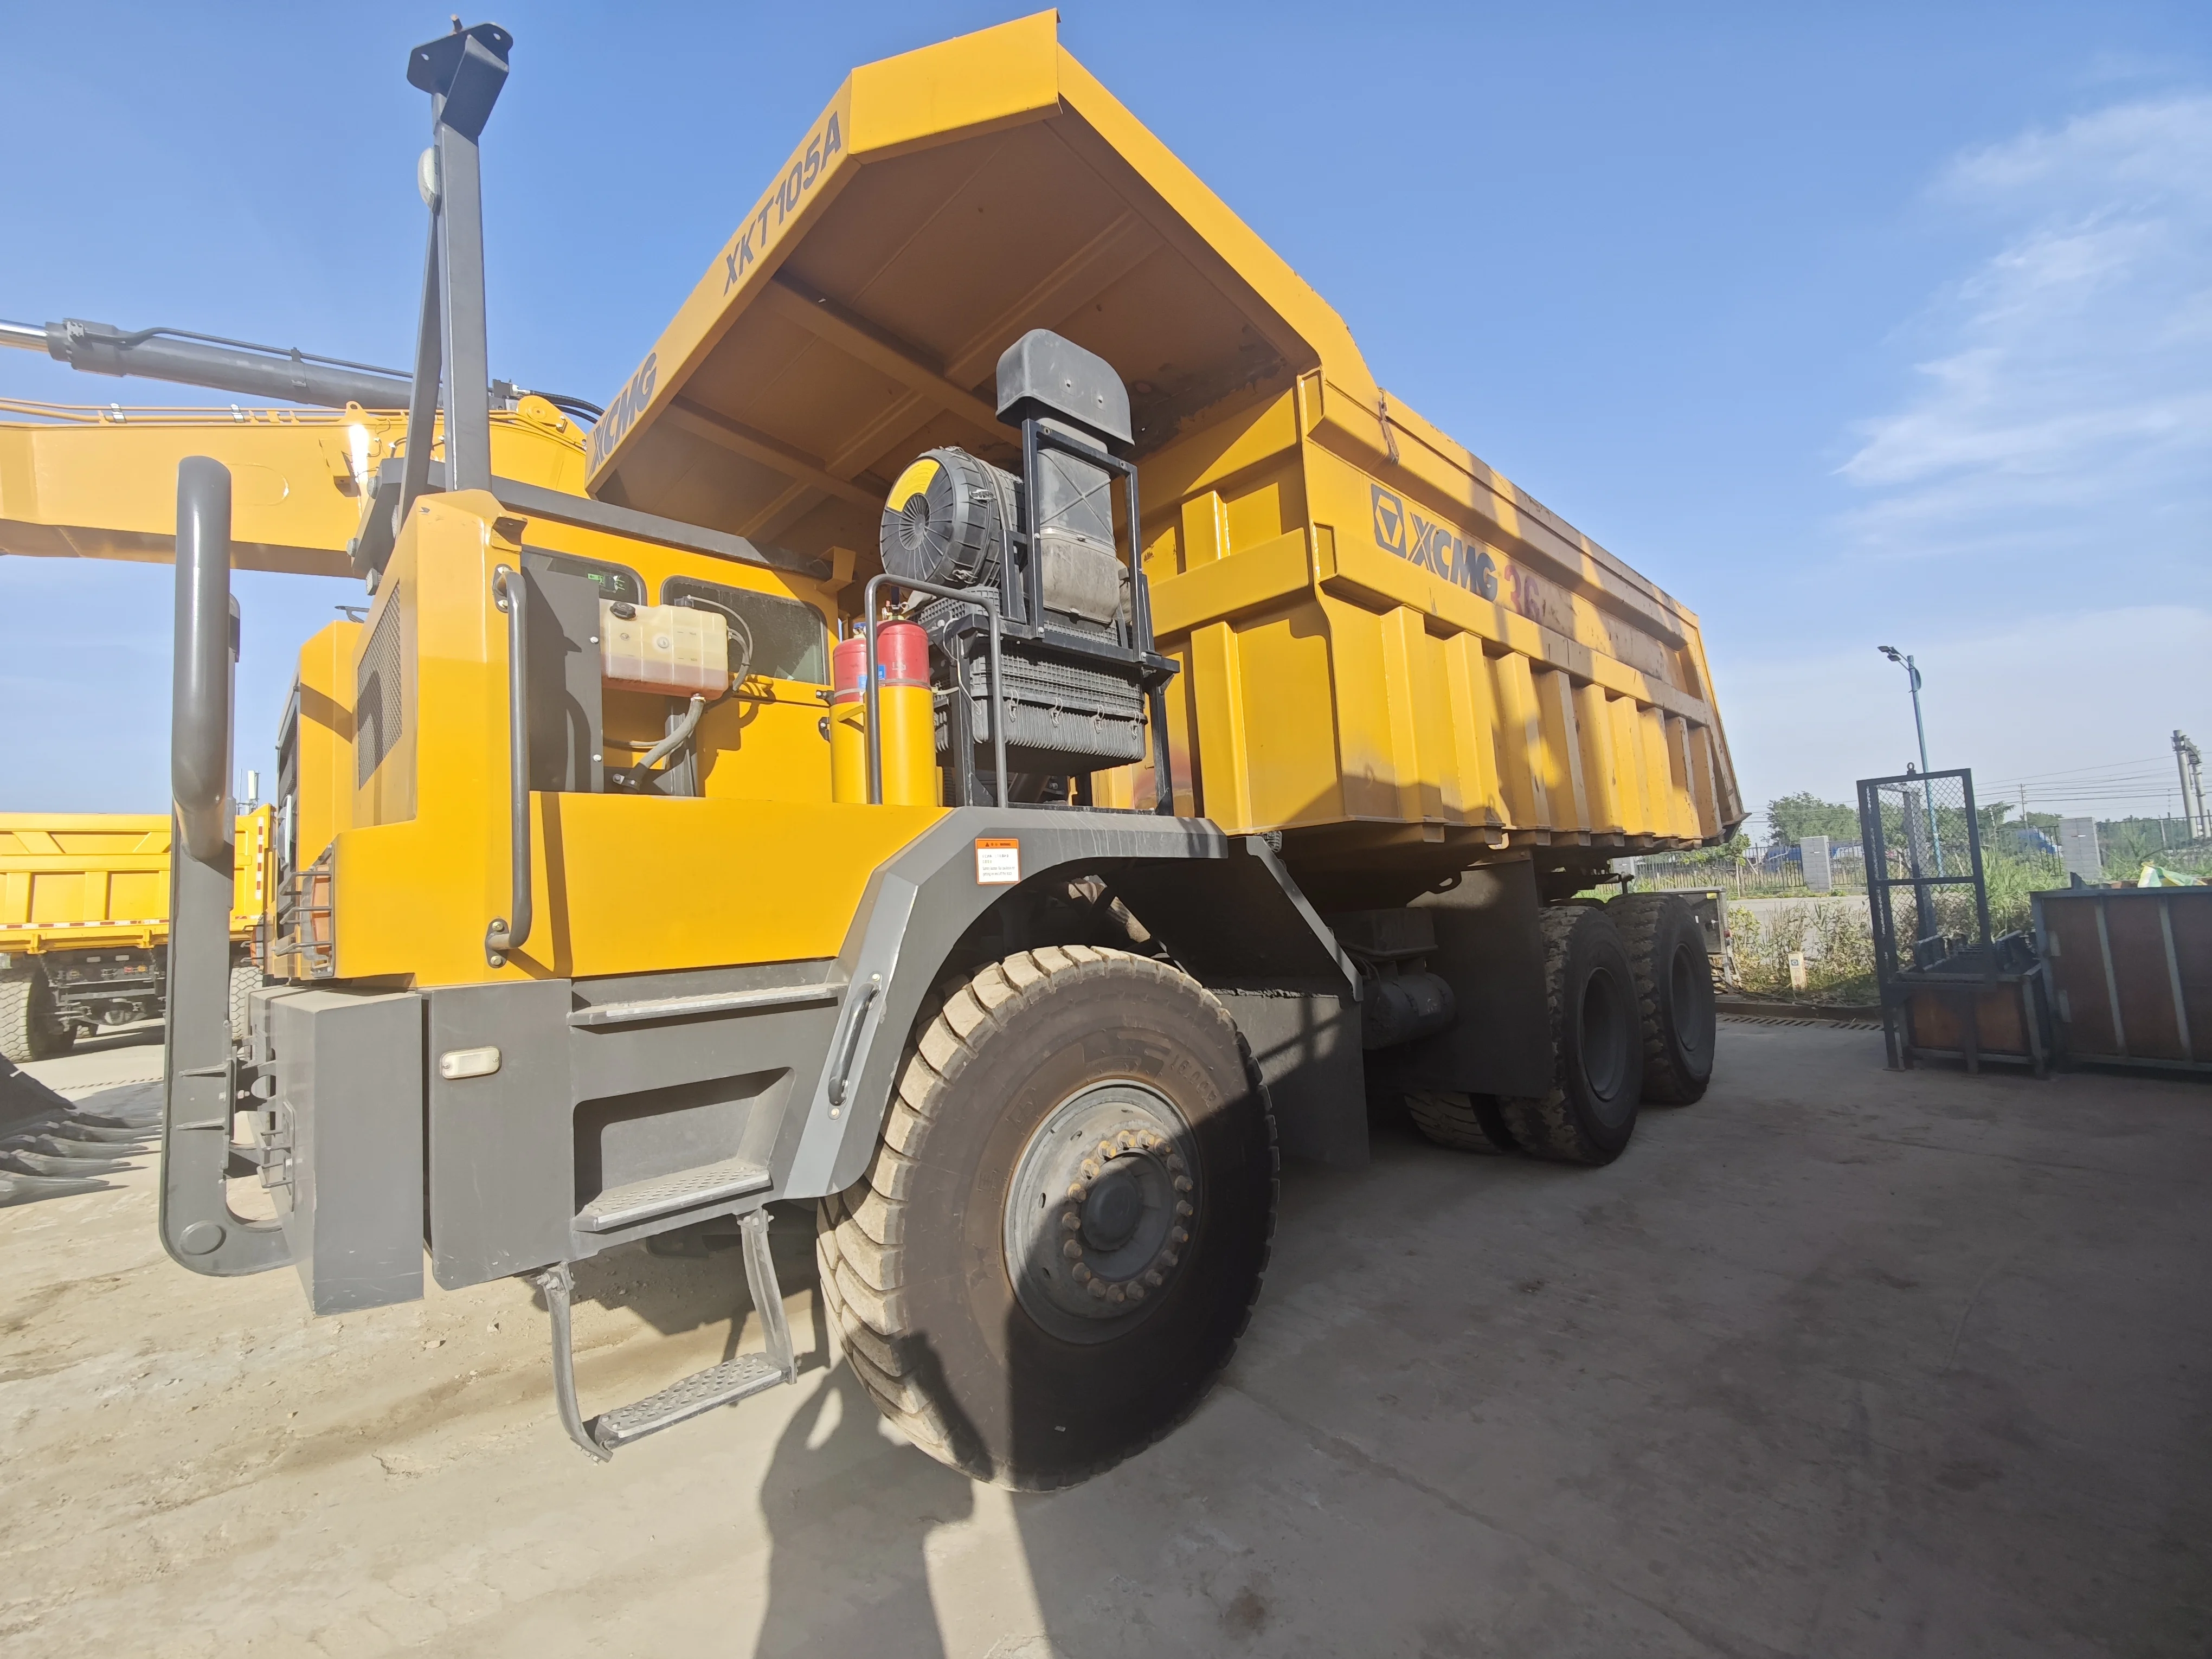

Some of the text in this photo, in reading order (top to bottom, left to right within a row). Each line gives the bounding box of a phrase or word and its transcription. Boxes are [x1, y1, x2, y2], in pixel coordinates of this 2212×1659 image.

[723, 111, 841, 298] XKT105A
[587, 352, 657, 480] XCMG
[1408, 511, 1498, 603] XCMG
